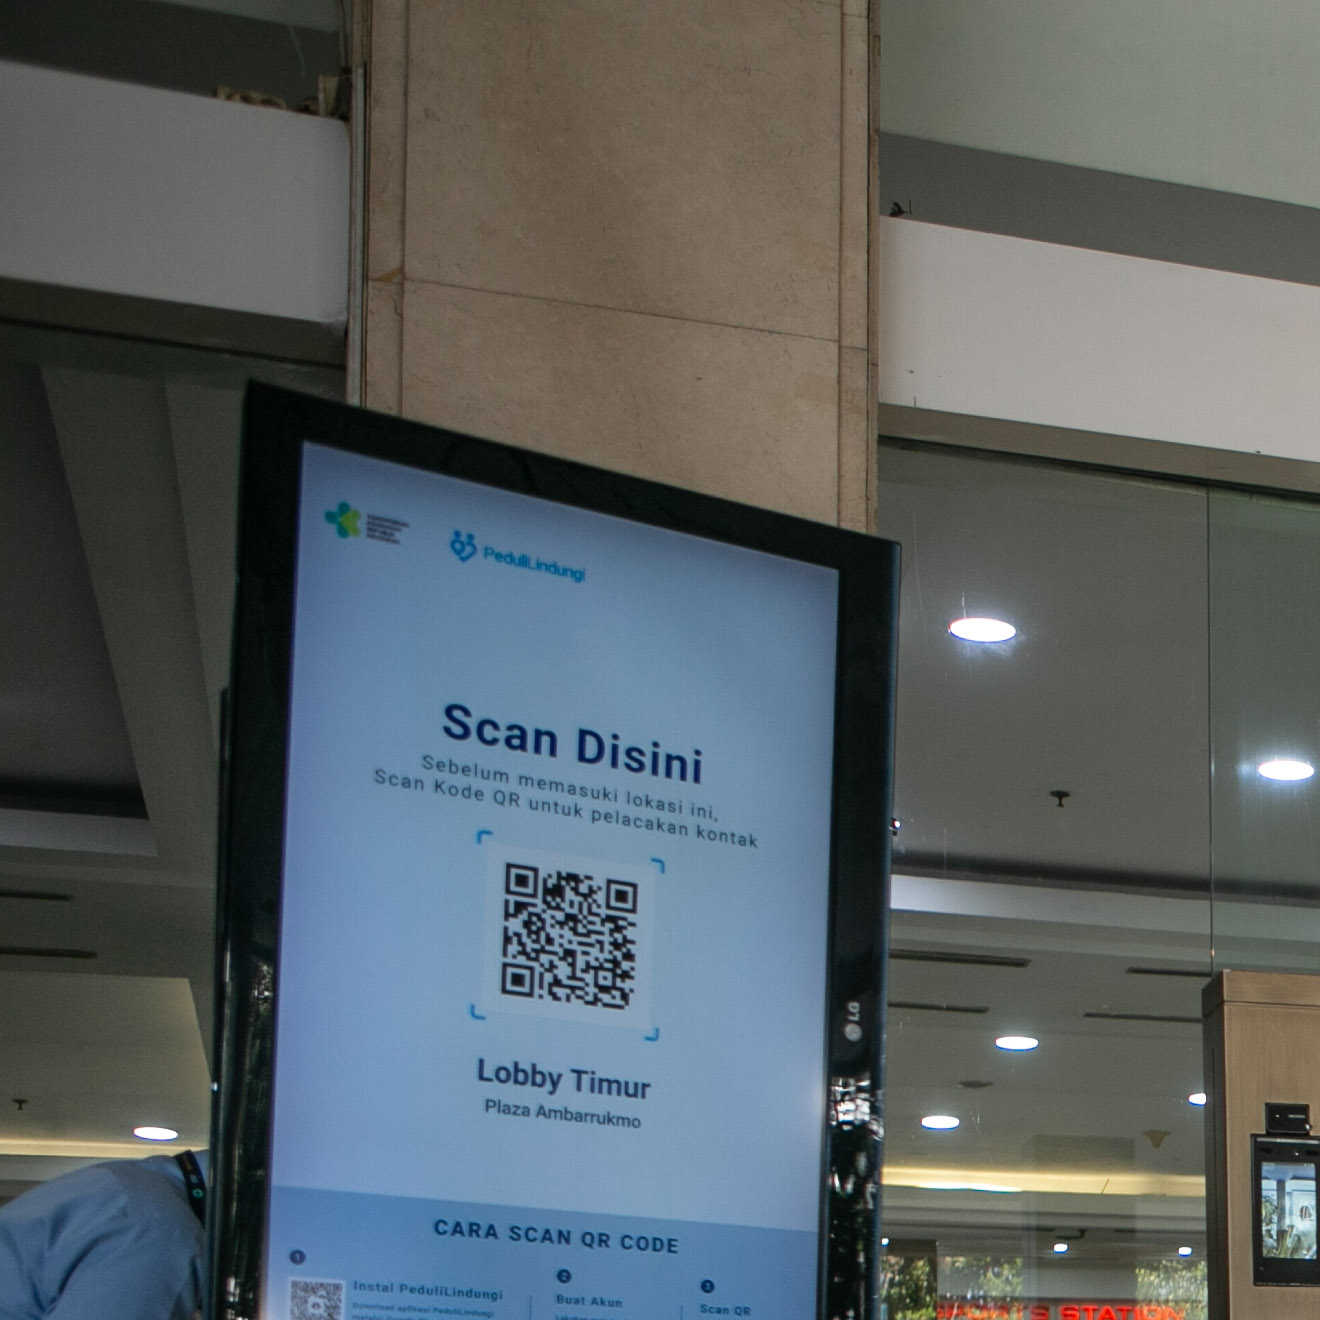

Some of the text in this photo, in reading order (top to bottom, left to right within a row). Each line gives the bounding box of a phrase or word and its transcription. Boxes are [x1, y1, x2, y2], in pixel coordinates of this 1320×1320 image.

[484, 546, 586, 583] PeduliLindungi
[443, 703, 702, 785] Scan Disini
[421, 754, 719, 823] Sebelum memasuki lokasi ini,
[374, 769, 758, 849] Scan Kode QR untuk pelacakan kontak
[477, 1057, 651, 1100] Lobby Timur
[485, 1098, 641, 1129] Plaza Ambarrukmo
[434, 1219, 679, 1254] CARA SCAN QR CODE
[353, 1281, 503, 1302] Instal PeduliLindungi
[556, 1294, 622, 1309] Buat Akun
[700, 1303, 751, 1318] Scan QR
